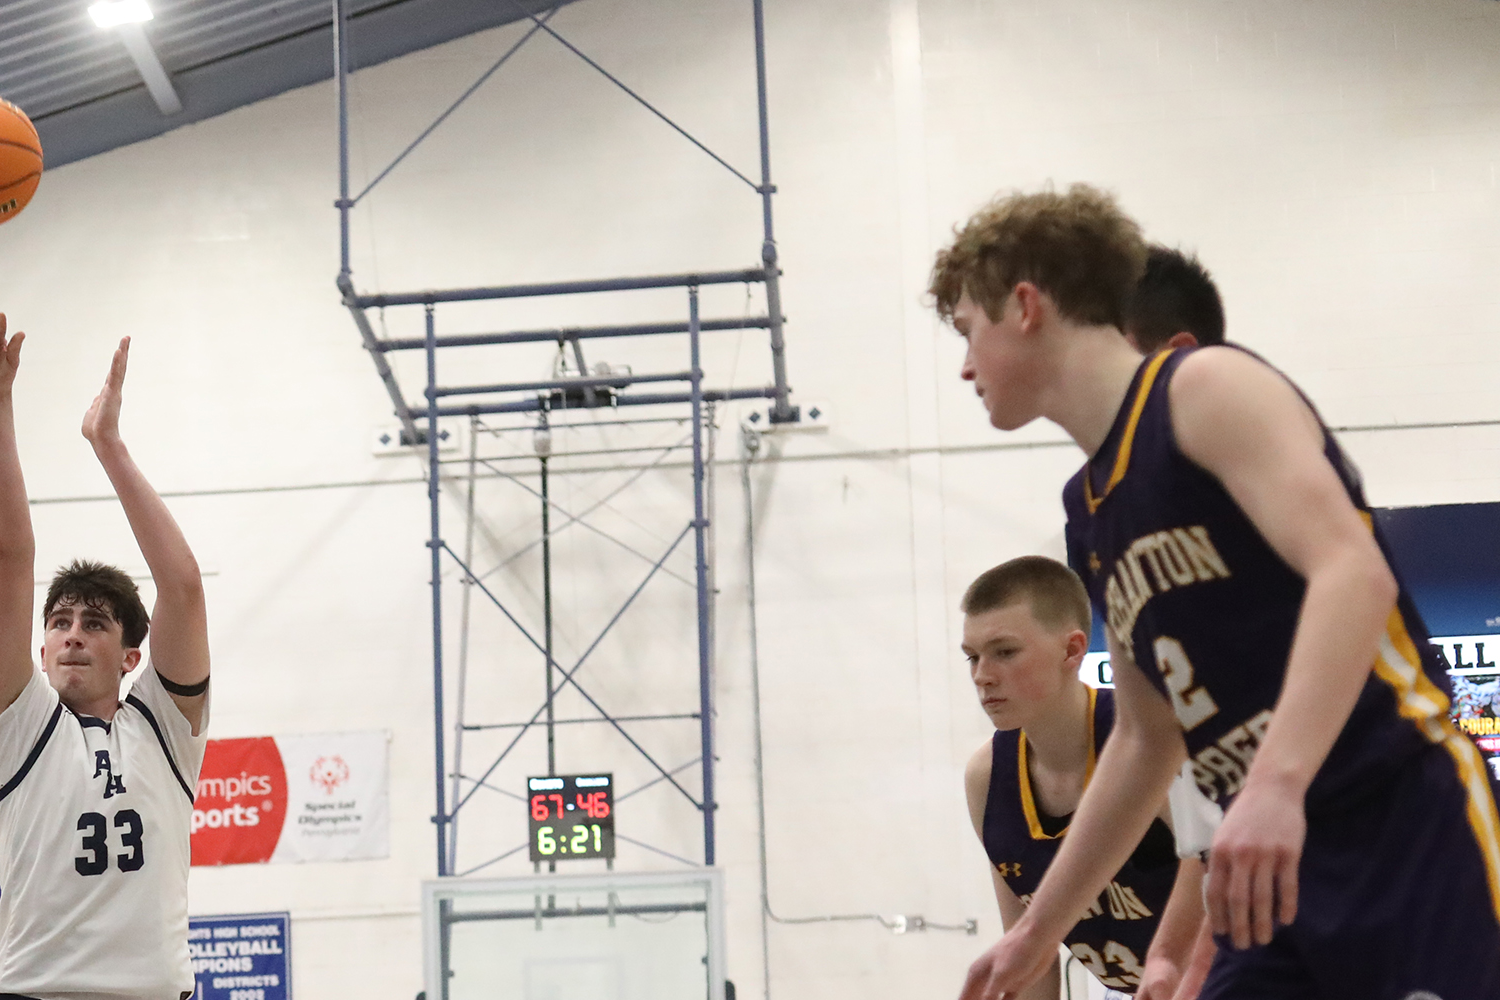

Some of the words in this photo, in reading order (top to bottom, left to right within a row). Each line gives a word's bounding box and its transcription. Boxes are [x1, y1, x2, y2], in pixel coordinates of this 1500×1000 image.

[1153, 635, 1220, 732] 2
[305, 800, 356, 815] Special
[531, 794, 564, 821] 67
[576, 791, 610, 819] 46
[297, 813, 362, 826] Olympics
[75, 808, 145, 877] 33
[537, 823, 603, 855] 6:21
[213, 926, 238, 939] HIGH
[240, 924, 281, 938] SCHOOL
[213, 973, 279, 989] DISTRICTS
